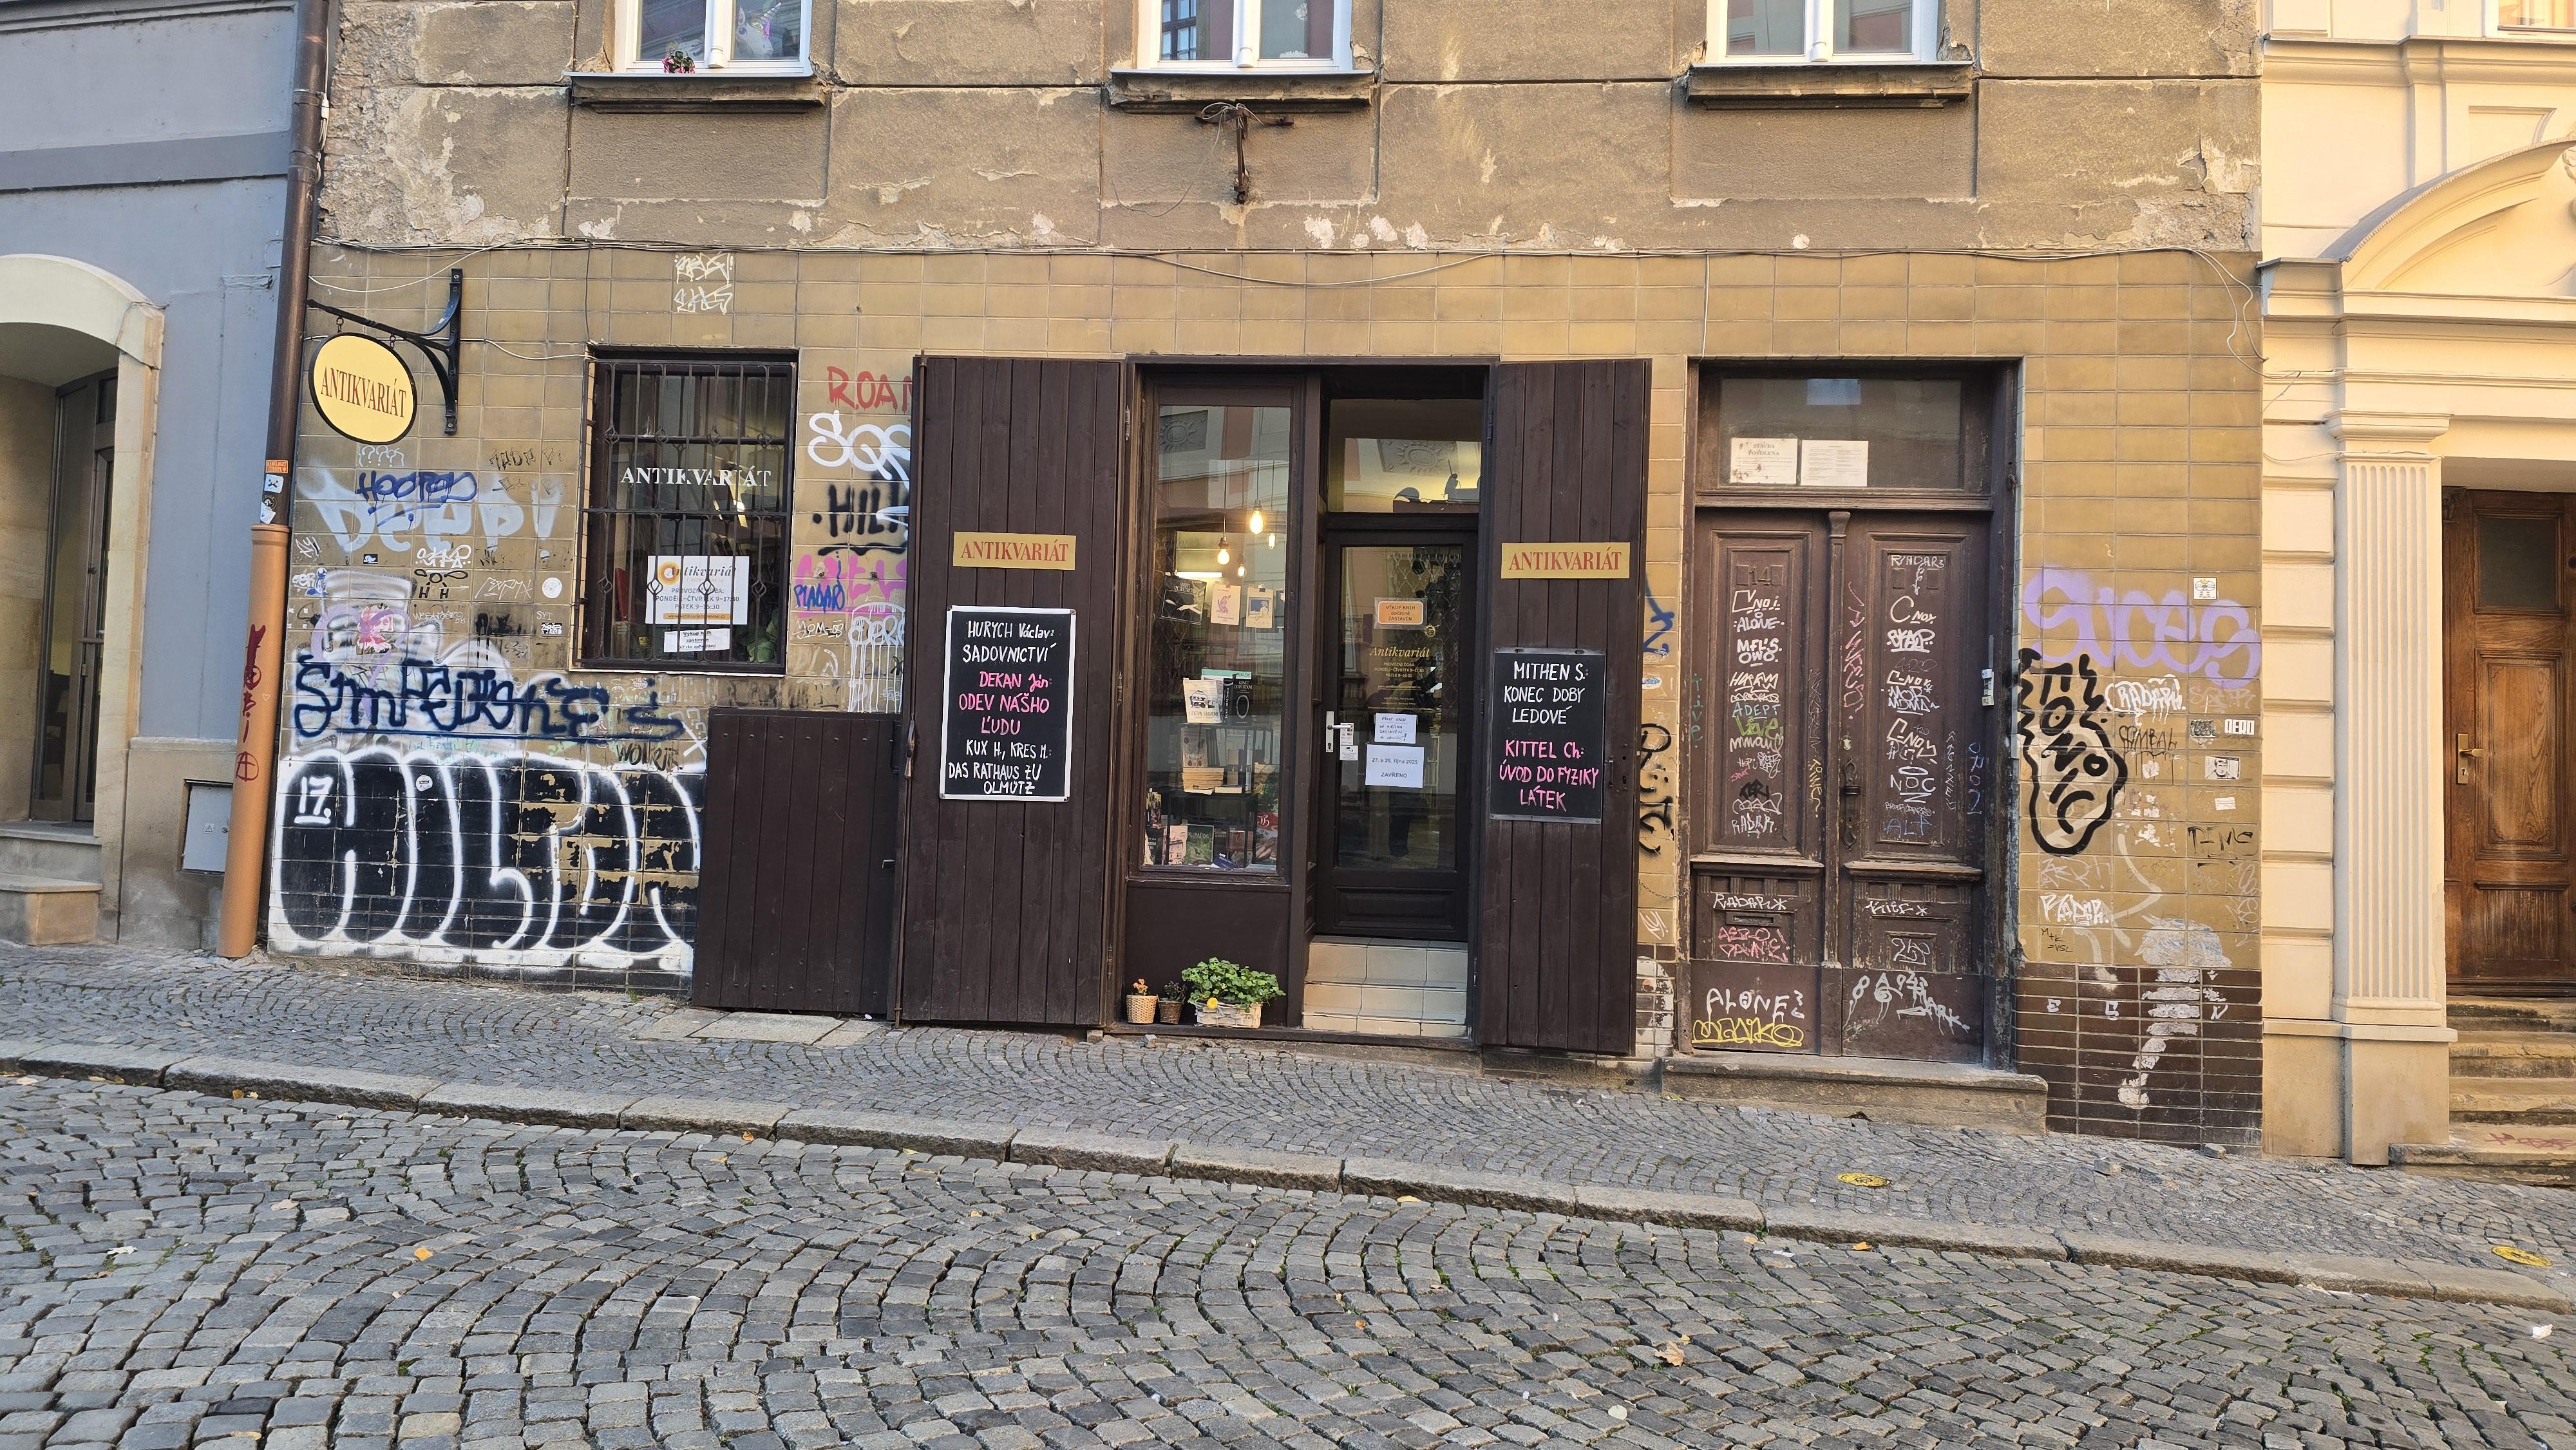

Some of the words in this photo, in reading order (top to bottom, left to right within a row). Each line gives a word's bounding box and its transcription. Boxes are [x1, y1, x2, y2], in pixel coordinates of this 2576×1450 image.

[321, 365, 406, 418] ANTIKVARIÁT
[961, 539, 1068, 561] ANTIKVARIÁT
[1508, 547, 1622, 570] ANTIKVARIÁT
[670, 565, 736, 576] Atikvariá
[967, 620, 1013, 638] HURYCH
[962, 642, 1057, 663] SADOVNICTVÍ
[1369, 646, 1431, 658] Antikvariát
[979, 671, 1021, 689] DEKAN
[1514, 661, 1570, 681] MITHEN
[959, 693, 994, 711] ODEV
[999, 693, 1050, 713] NÁŠHO
[1504, 685, 1544, 703] KONEC
[1553, 686, 1586, 703] DOBY
[1512, 705, 1573, 724] LEDOVÉ
[981, 716, 1021, 735] ĽUDU
[966, 740, 987, 756] KUX
[1010, 742, 1036, 759] KRES
[1505, 740, 1557, 758] KITTEL
[949, 762, 968, 778] DAS
[973, 763, 1019, 780] RATHAUS
[1025, 764, 1041, 780] ZU
[1499, 759, 1532, 783] ÚVOD
[1537, 766, 1554, 782] DO
[1558, 767, 1599, 788] FYZIKY
[1520, 786, 1567, 812] LÁTEK
